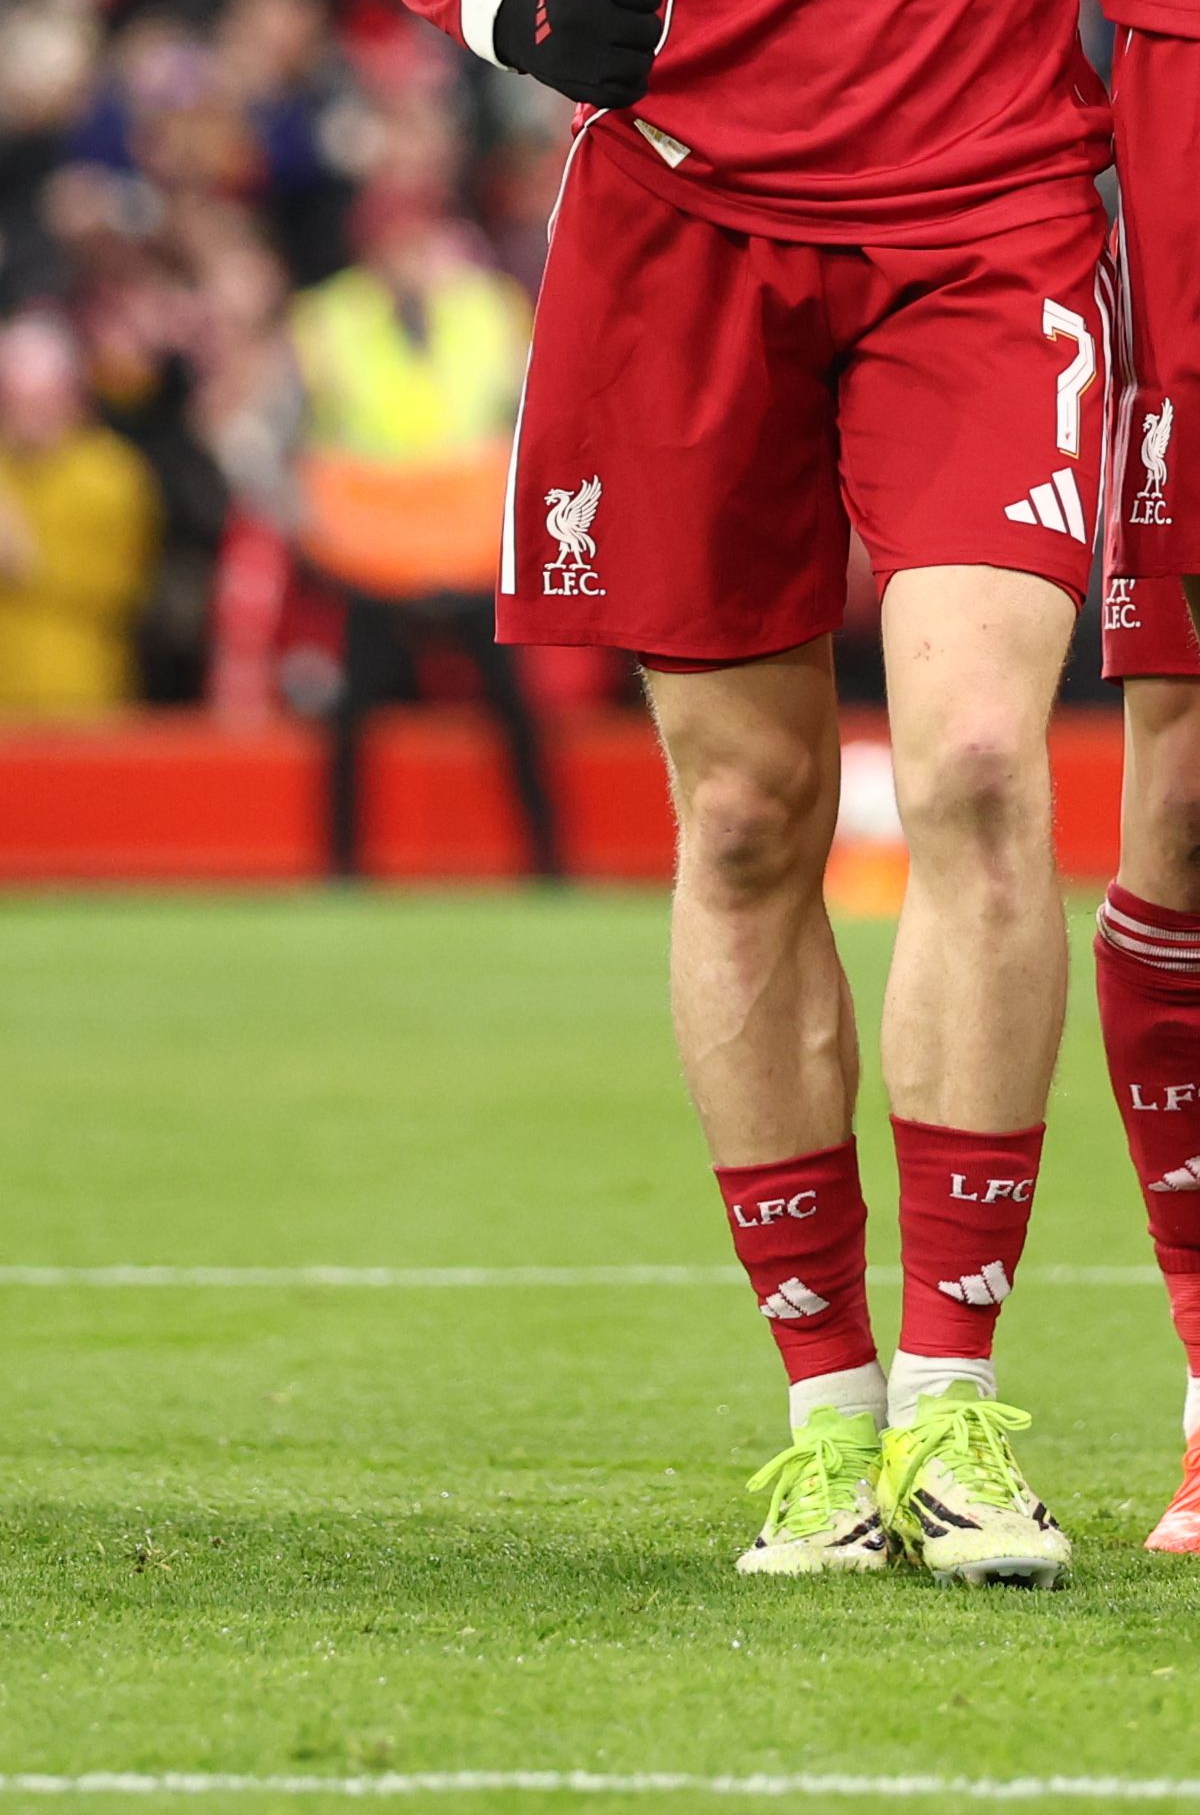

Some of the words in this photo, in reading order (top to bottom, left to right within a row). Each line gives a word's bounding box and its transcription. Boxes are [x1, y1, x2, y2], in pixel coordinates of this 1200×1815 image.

[1042, 297, 1097, 460] 7
[1129, 499, 1172, 525] L.F.C.
[542, 571, 606, 596] L.F.C.
[949, 1172, 1035, 1204] LFC
[733, 1189, 818, 1228] LFC
